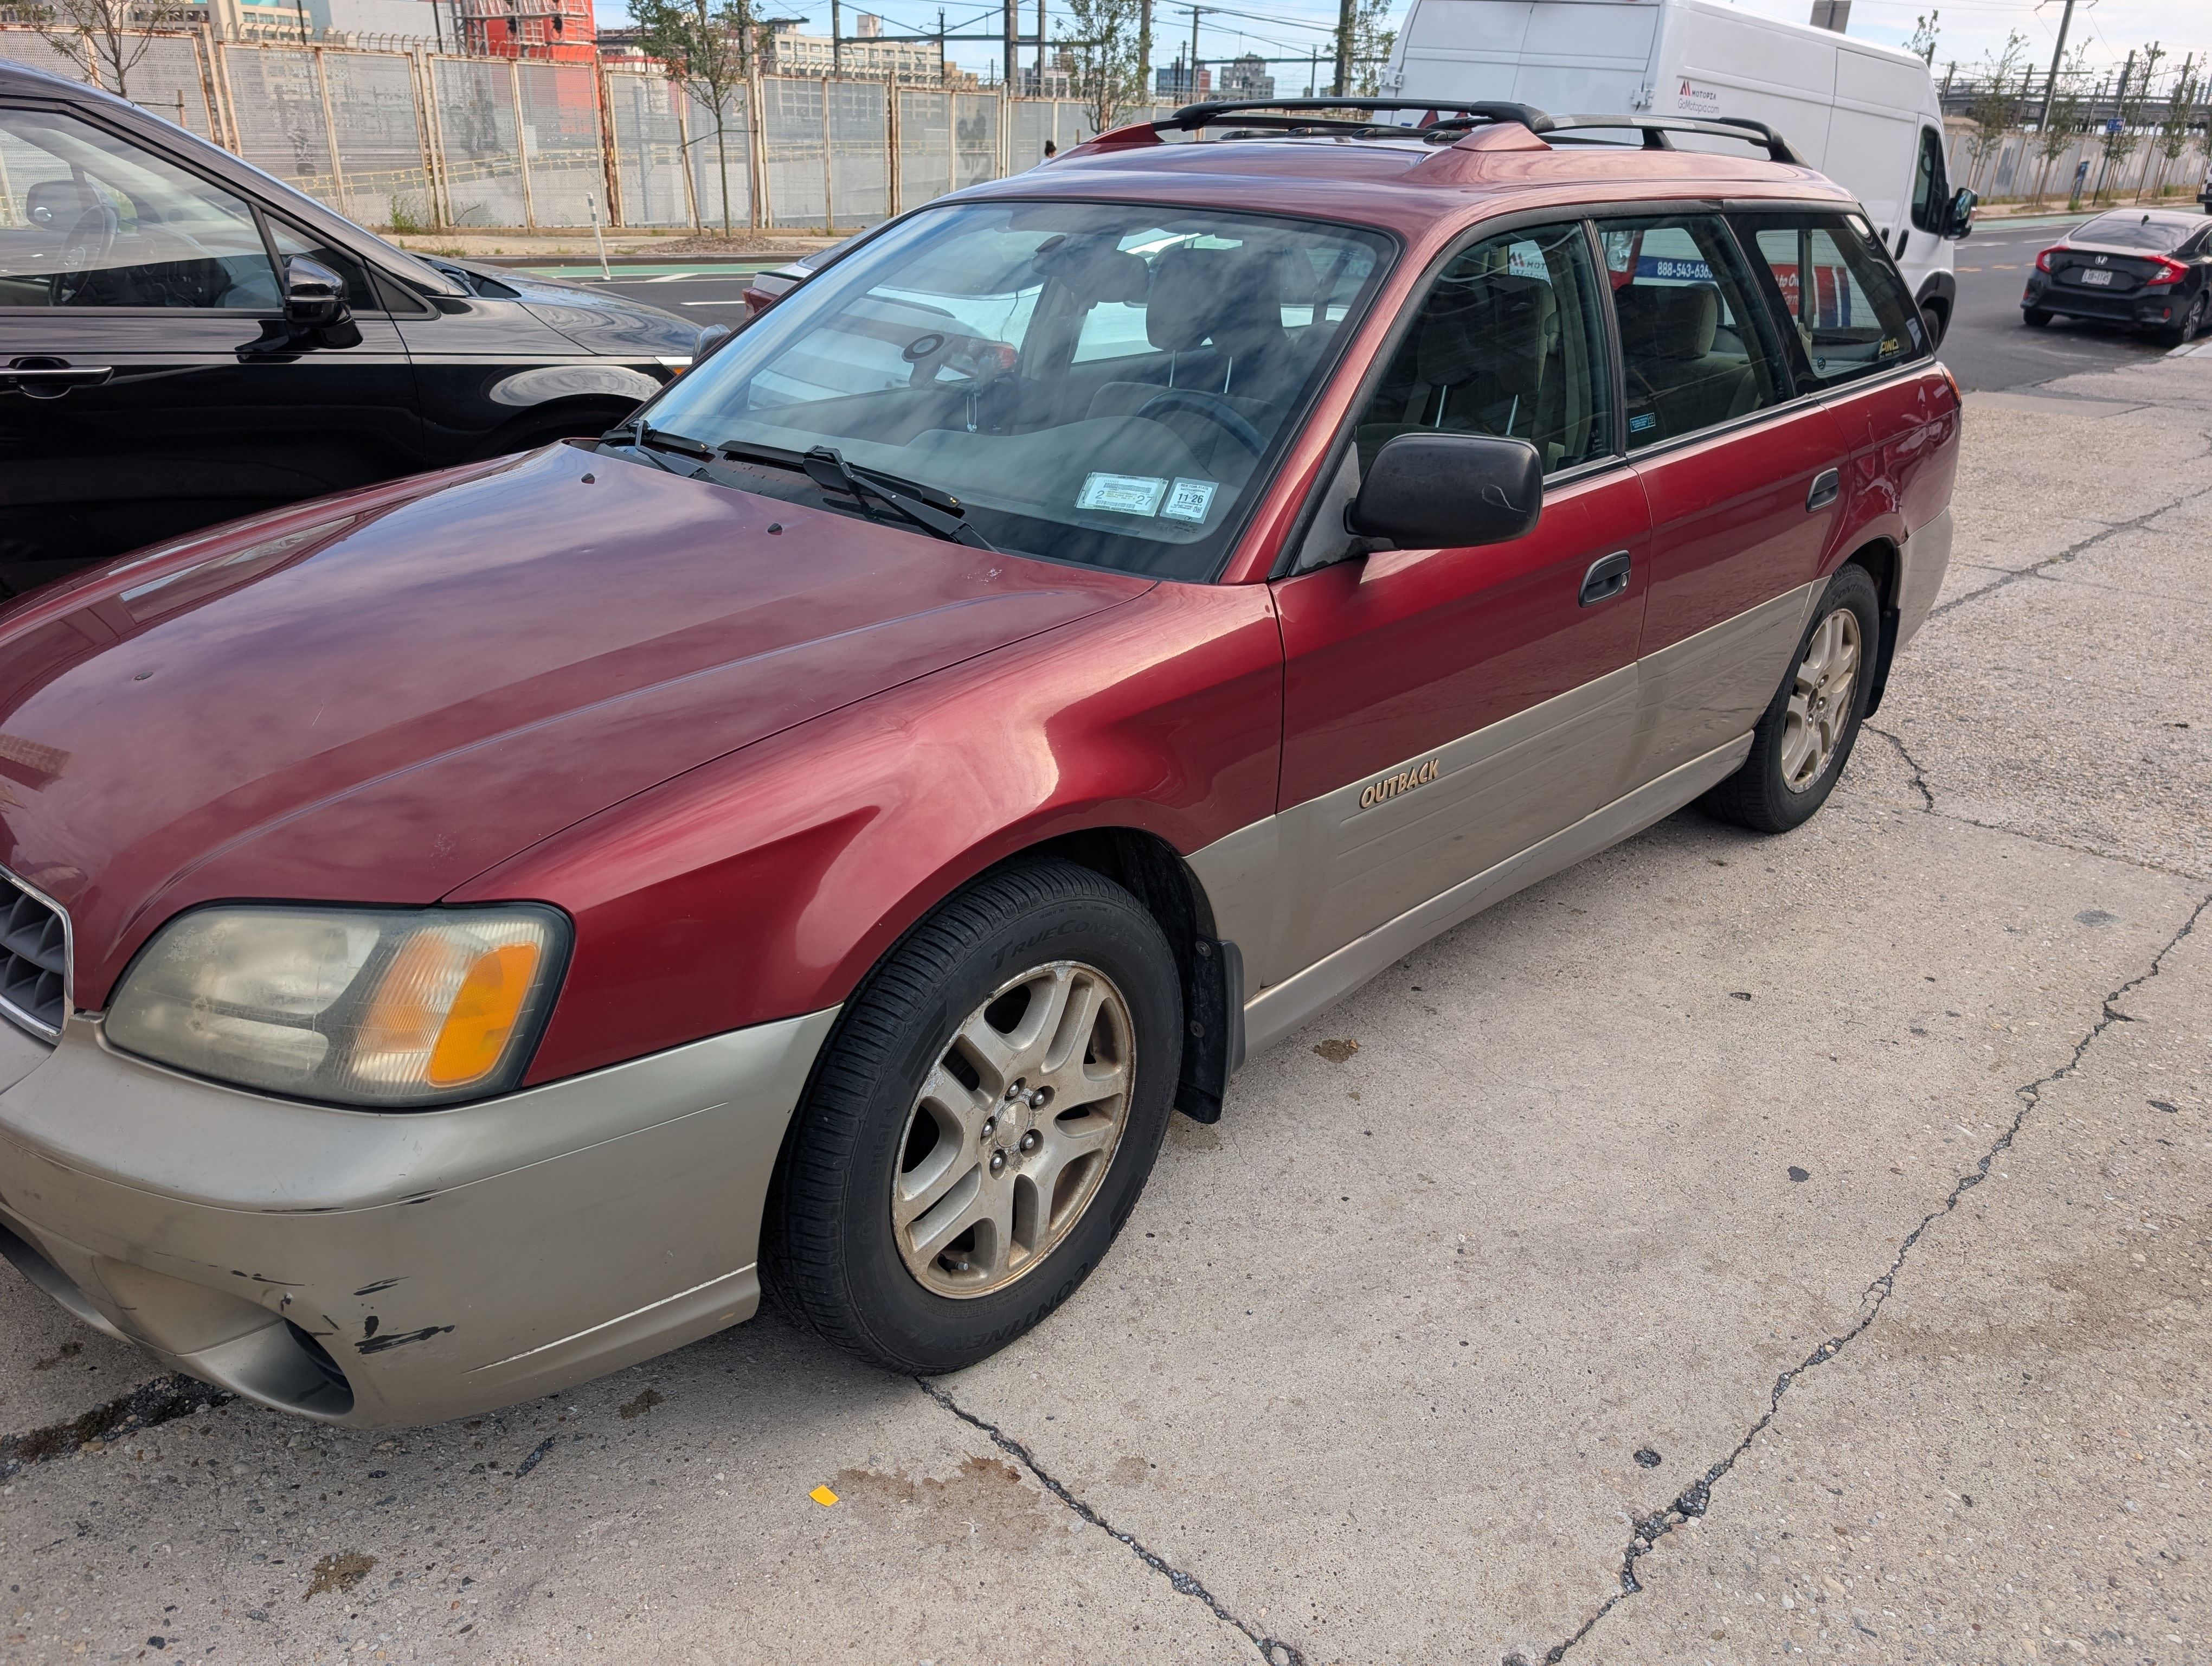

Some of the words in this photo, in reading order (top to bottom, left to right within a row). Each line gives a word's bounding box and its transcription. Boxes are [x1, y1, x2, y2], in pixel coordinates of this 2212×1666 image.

[1692, 91, 1716, 100] MOTOPIA
[1678, 98, 1719, 114] GoMotopia.com
[1879, 337, 1899, 354] AWD
[1095, 490, 1104, 499] 2
[1135, 495, 1153, 506] 27
[1359, 758, 1439, 809] OUTBACK
